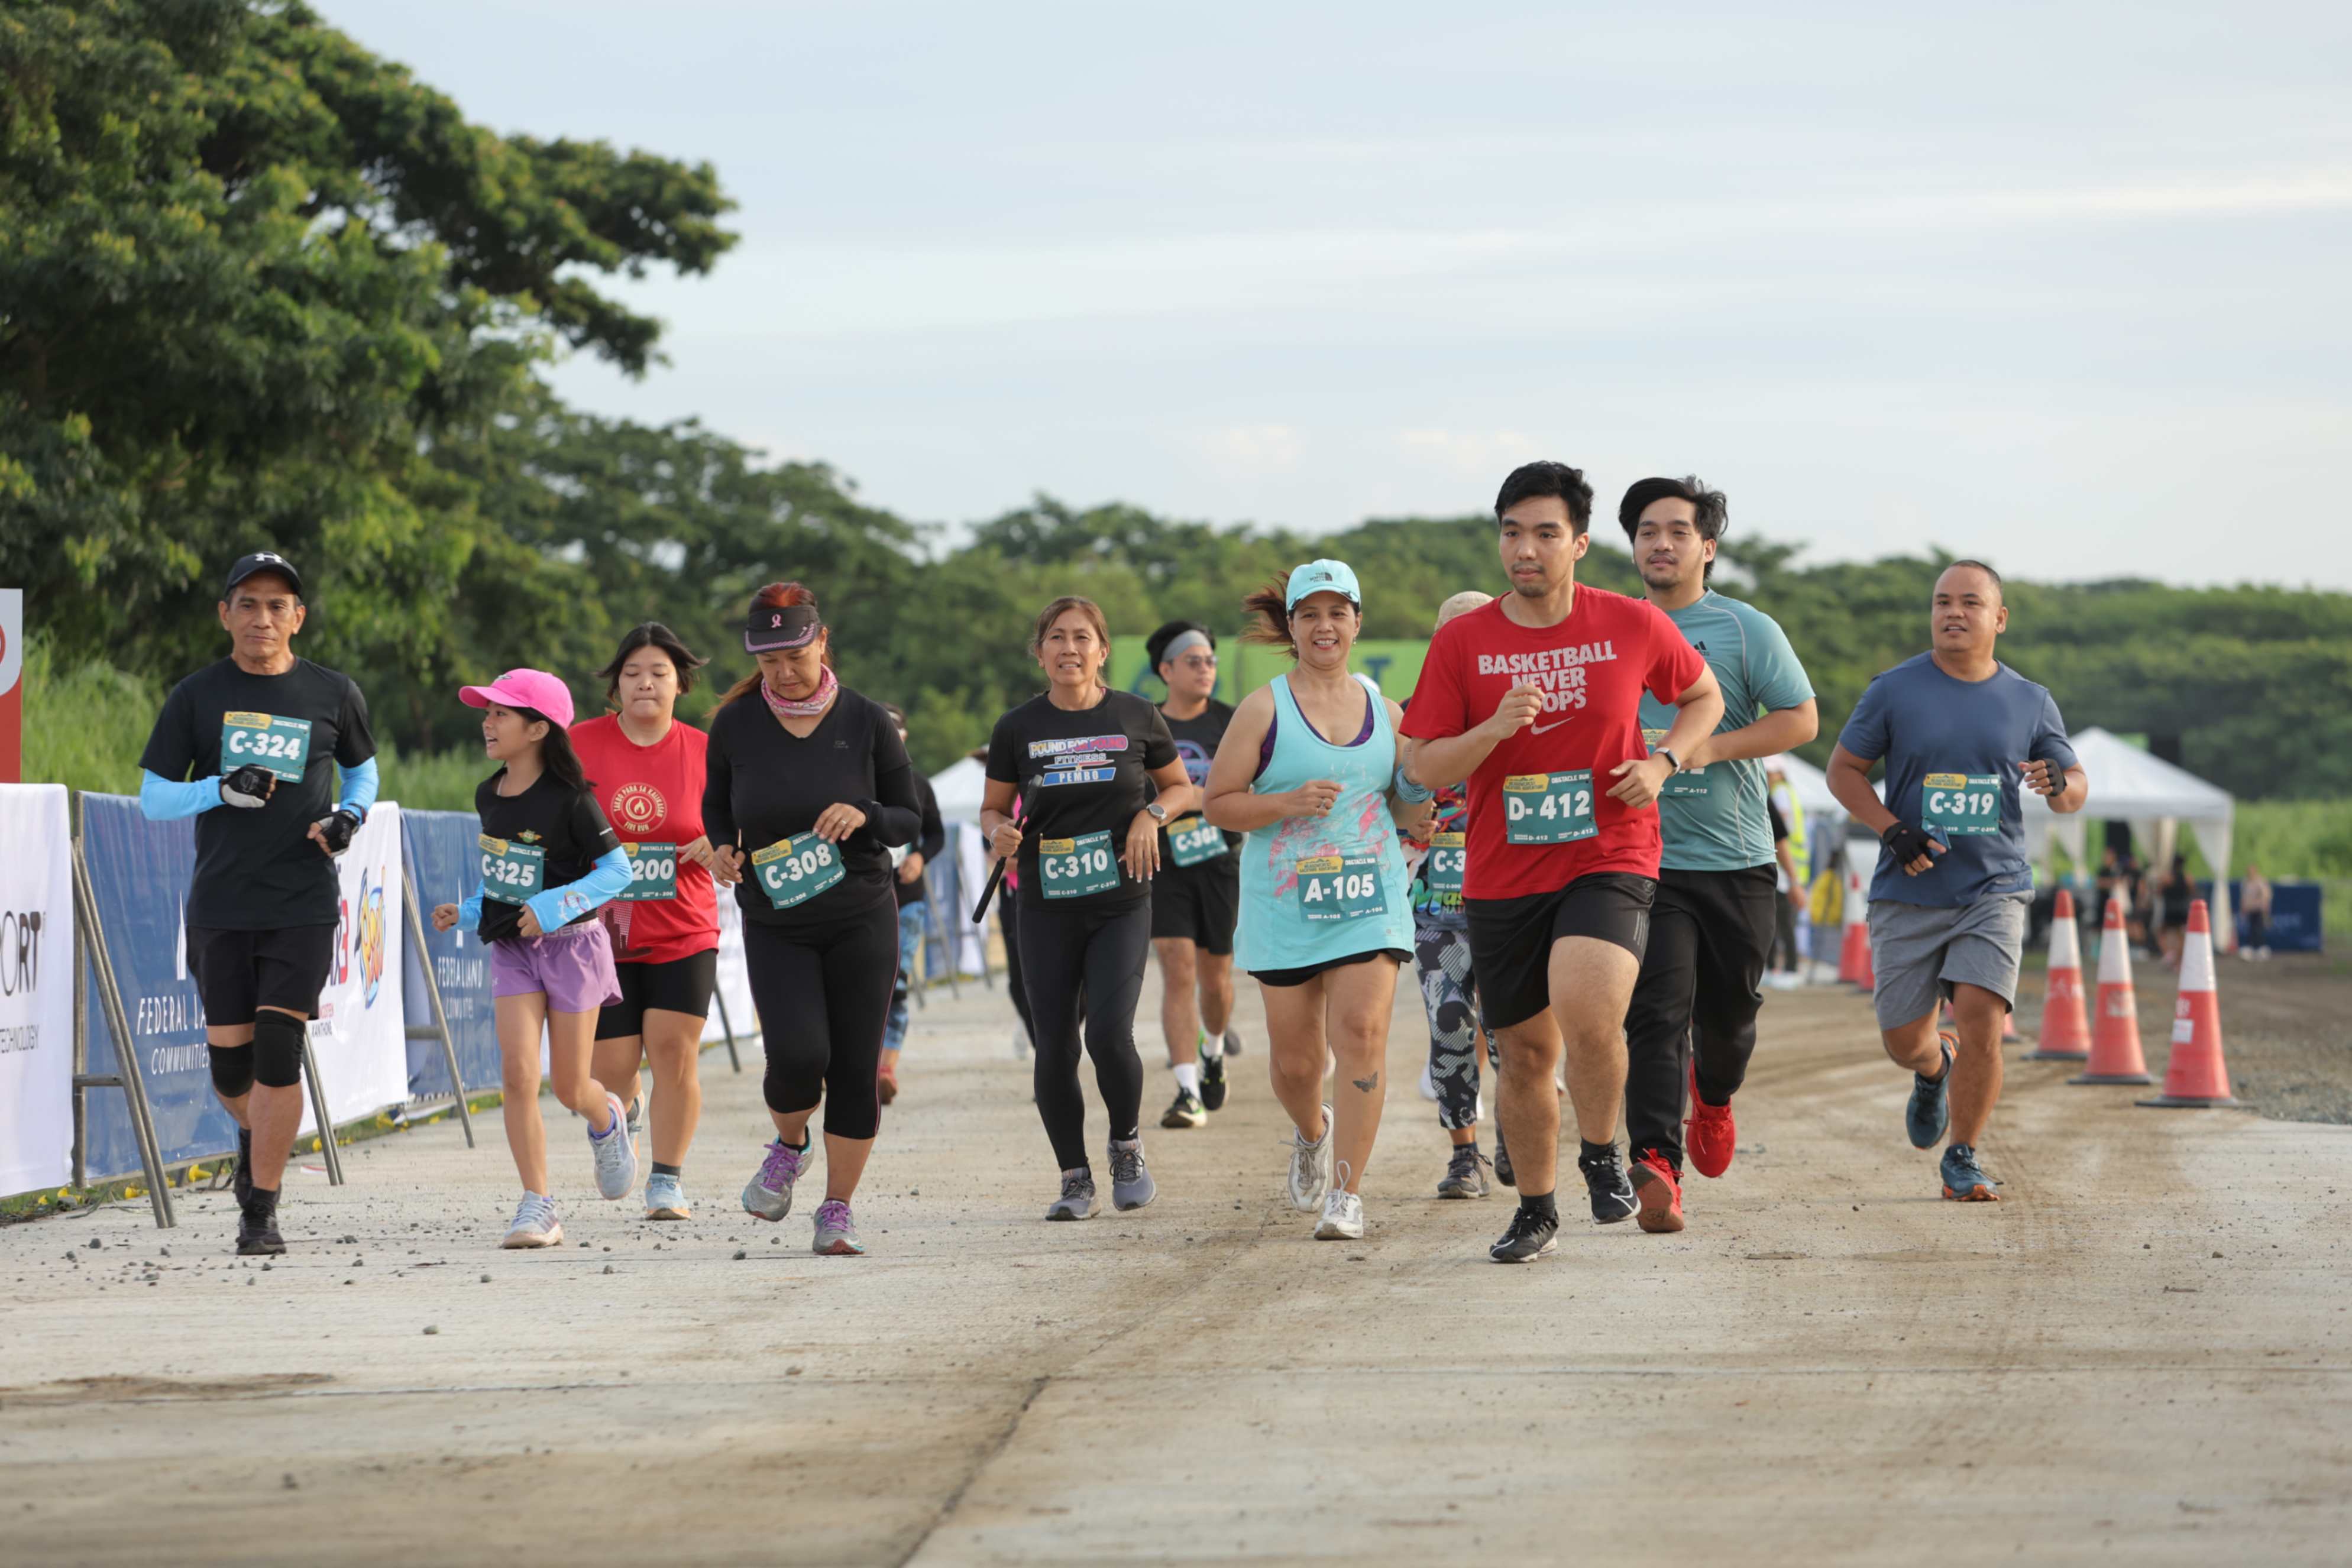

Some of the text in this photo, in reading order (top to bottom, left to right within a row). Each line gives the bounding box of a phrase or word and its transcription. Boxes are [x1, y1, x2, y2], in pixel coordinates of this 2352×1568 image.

[1478, 640, 1617, 675] BASKETBALL
[1512, 666, 1587, 691] NEVER
[1542, 688, 1587, 712] OPS
[229, 730, 301, 760] C-324
[1031, 737, 1125, 756] POUND FOR POUND
[1054, 753, 1107, 764] FITNESS
[622, 785, 638, 795] PARA
[1059, 770, 1099, 783] PEMBO
[1539, 790, 1590, 820] 412
[1930, 791, 1994, 815] C-319
[624, 821, 649, 832] FIRE RUN
[482, 854, 536, 887] C-325
[765, 843, 832, 889] C-308
[1045, 849, 1108, 879] C-310
[1434, 850, 1467, 872] C-3
[1303, 873, 1375, 903] A-105
[0, 911, 41, 997] ORT
[137, 996, 187, 1035] FEDERAL
[151, 1042, 211, 1075] COMMUNITIES
